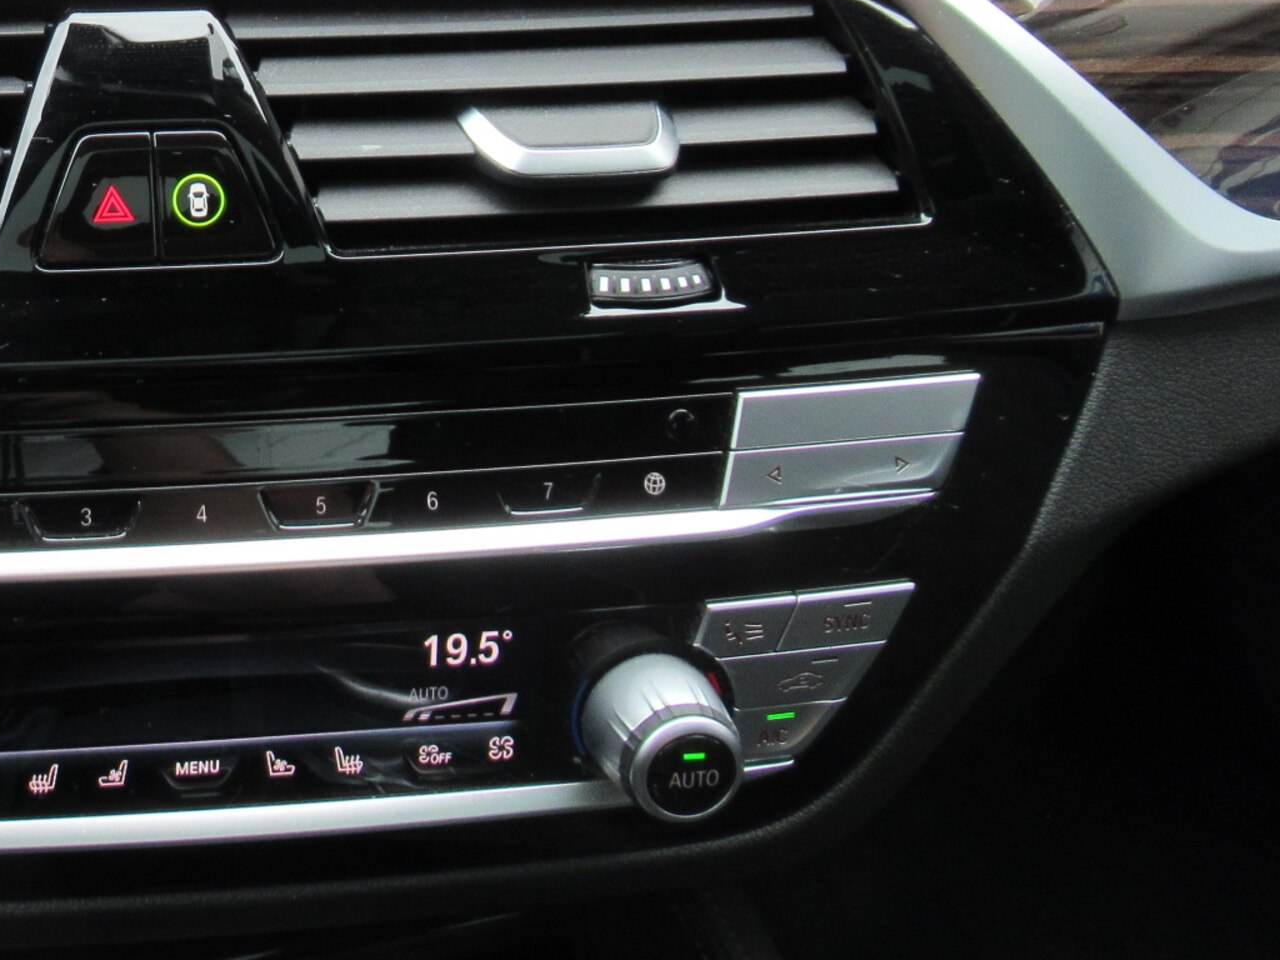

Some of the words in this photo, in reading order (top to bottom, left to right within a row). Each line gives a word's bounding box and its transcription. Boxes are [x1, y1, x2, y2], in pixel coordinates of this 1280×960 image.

[426, 490, 439, 511] 6
[543, 482, 554, 500] 7
[195, 504, 208, 523] 4
[315, 496, 327, 515] 5
[80, 507, 93, 527] 3
[823, 612, 871, 634] SYNC
[408, 686, 449, 702] AUTO
[430, 751, 452, 765] OFF
[175, 759, 220, 777] MENU
[668, 769, 720, 790] AUTO
